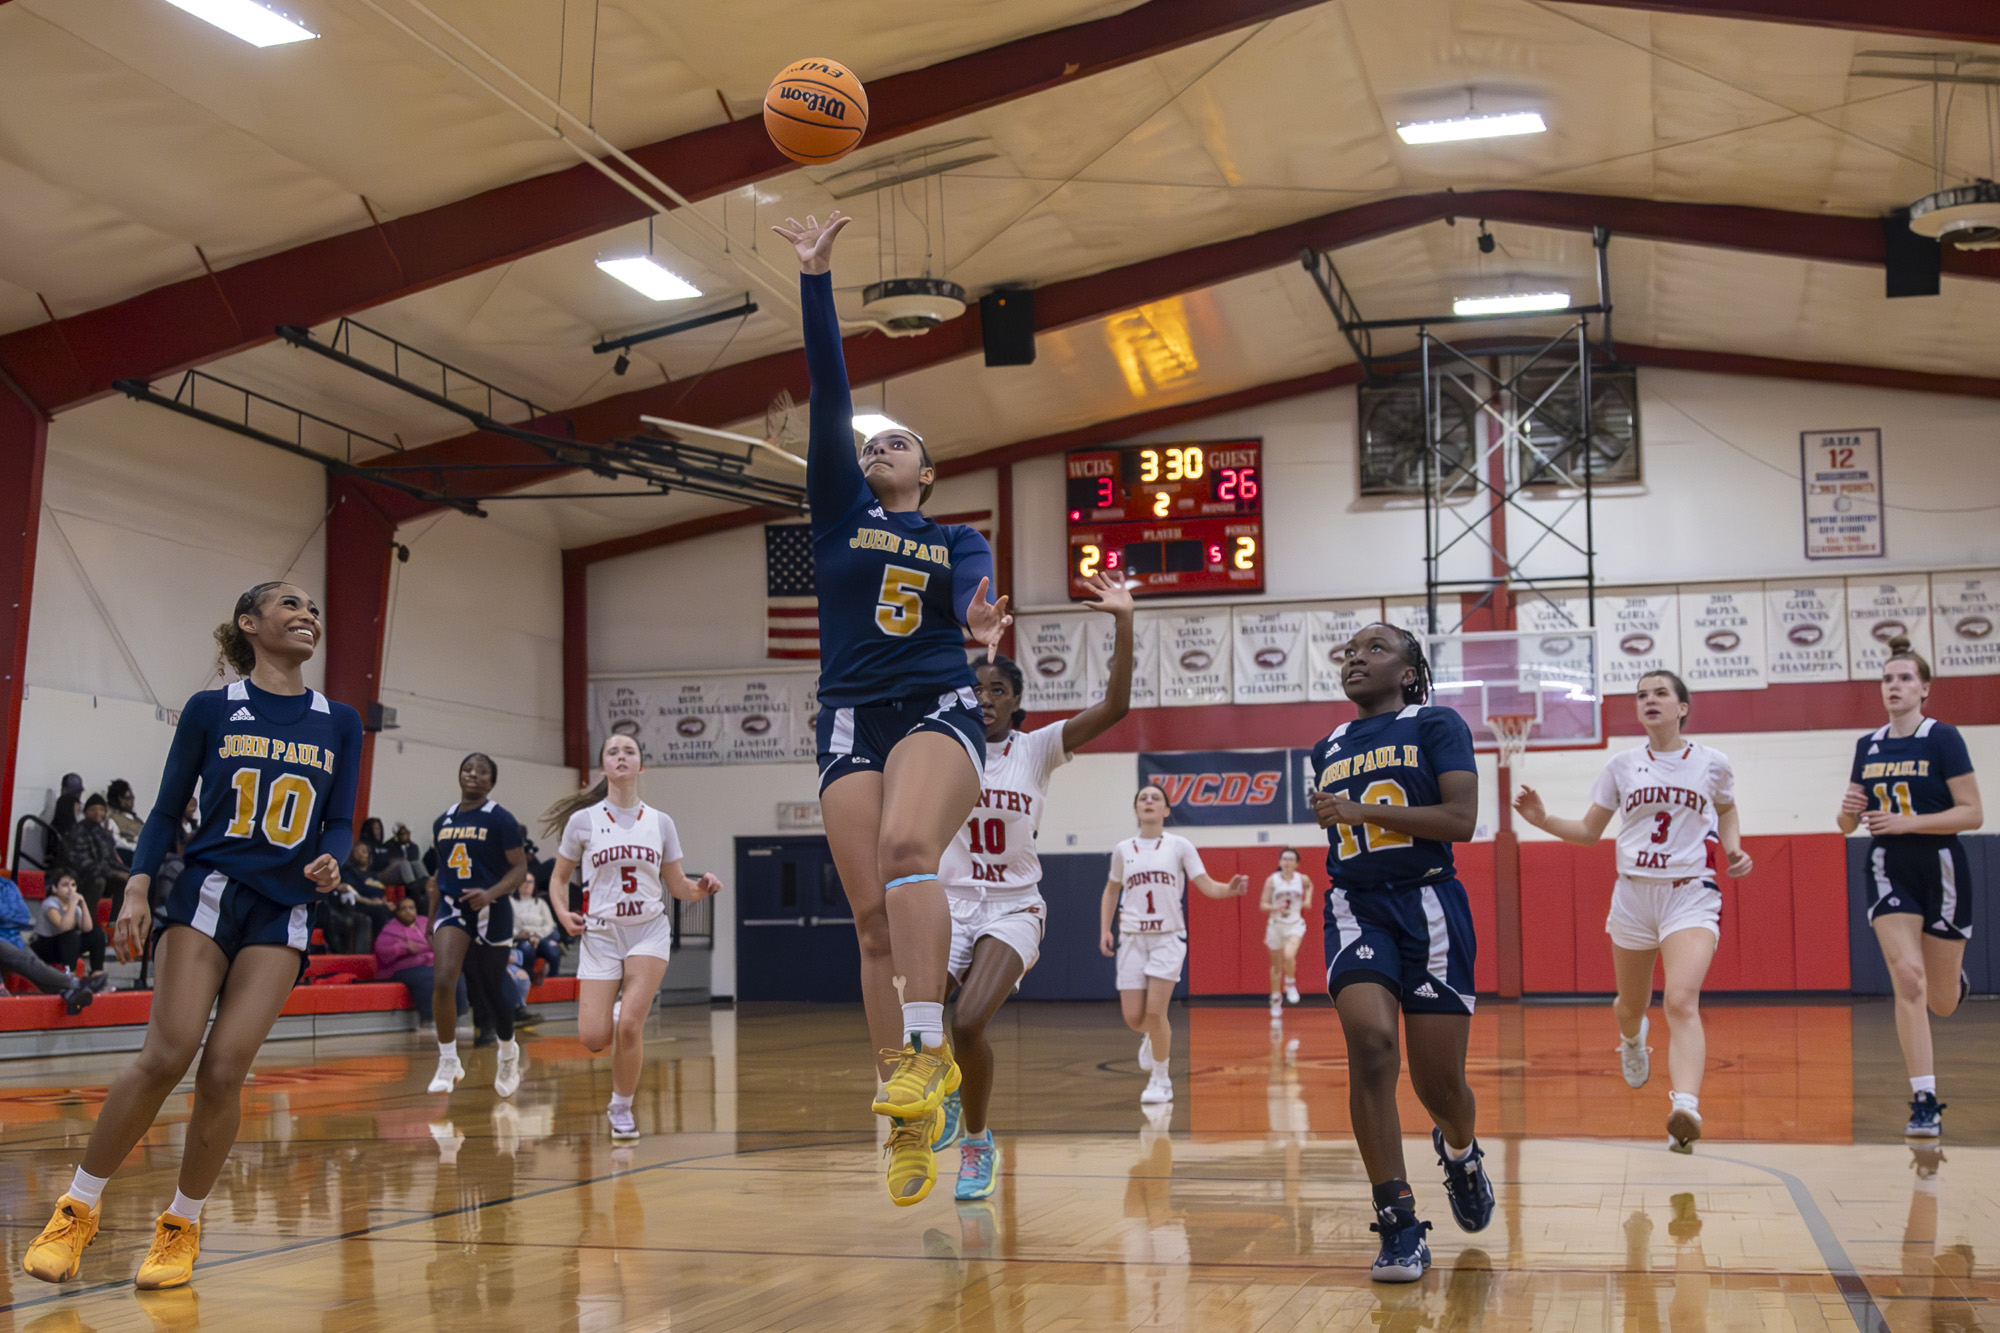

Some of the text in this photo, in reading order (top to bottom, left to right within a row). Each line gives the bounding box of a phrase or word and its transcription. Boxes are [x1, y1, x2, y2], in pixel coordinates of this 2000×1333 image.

[780, 86, 846, 121] Wilson
[1069, 459, 1113, 477] WCDS
[1208, 450, 1256, 469] GUEST
[1829, 448, 1855, 469] 12
[1097, 478, 1113, 507] 3
[1218, 469, 1257, 500] 26
[1153, 491, 1171, 517] 2
[850, 528, 901, 553] JOHN
[1234, 537, 1256, 569] 2
[1080, 545, 1100, 578] 2
[1106, 551, 1118, 569] 3
[875, 564, 930, 637] 5
[1785, 600, 1824, 610] GIRLS
[1618, 611, 1655, 620] GIRLS
[1695, 617, 1748, 627] SOCCER
[1689, 667, 1759, 678] CHAMPION
[1772, 661, 1842, 673] CHAMPION
[1239, 684, 1303, 695] CHAMPION
[218, 735, 335, 775] JOHN PAUL II
[1353, 745, 1402, 775] PAUL
[1403, 745, 1418, 767] II
[1885, 761, 1917, 777] PAUL
[975, 788, 1033, 815] NTRY
[1148, 771, 1282, 808] WCDS
[1626, 787, 1708, 815] COUNTRY
[1873, 781, 1918, 817] 11
[224, 767, 317, 850] 10
[1334, 778, 1414, 860] 12
[968, 817, 1006, 855] 10
[1651, 811, 1672, 845] 3
[448, 843, 472, 879] 4
[592, 845, 662, 869] COUNTRY
[1636, 851, 1672, 869] DAY
[621, 866, 638, 894] 5
[972, 861, 1008, 882] DAY
[616, 901, 645, 917] DAY
[1146, 890, 1156, 914] 1
[1140, 919, 1164, 931] DAY
